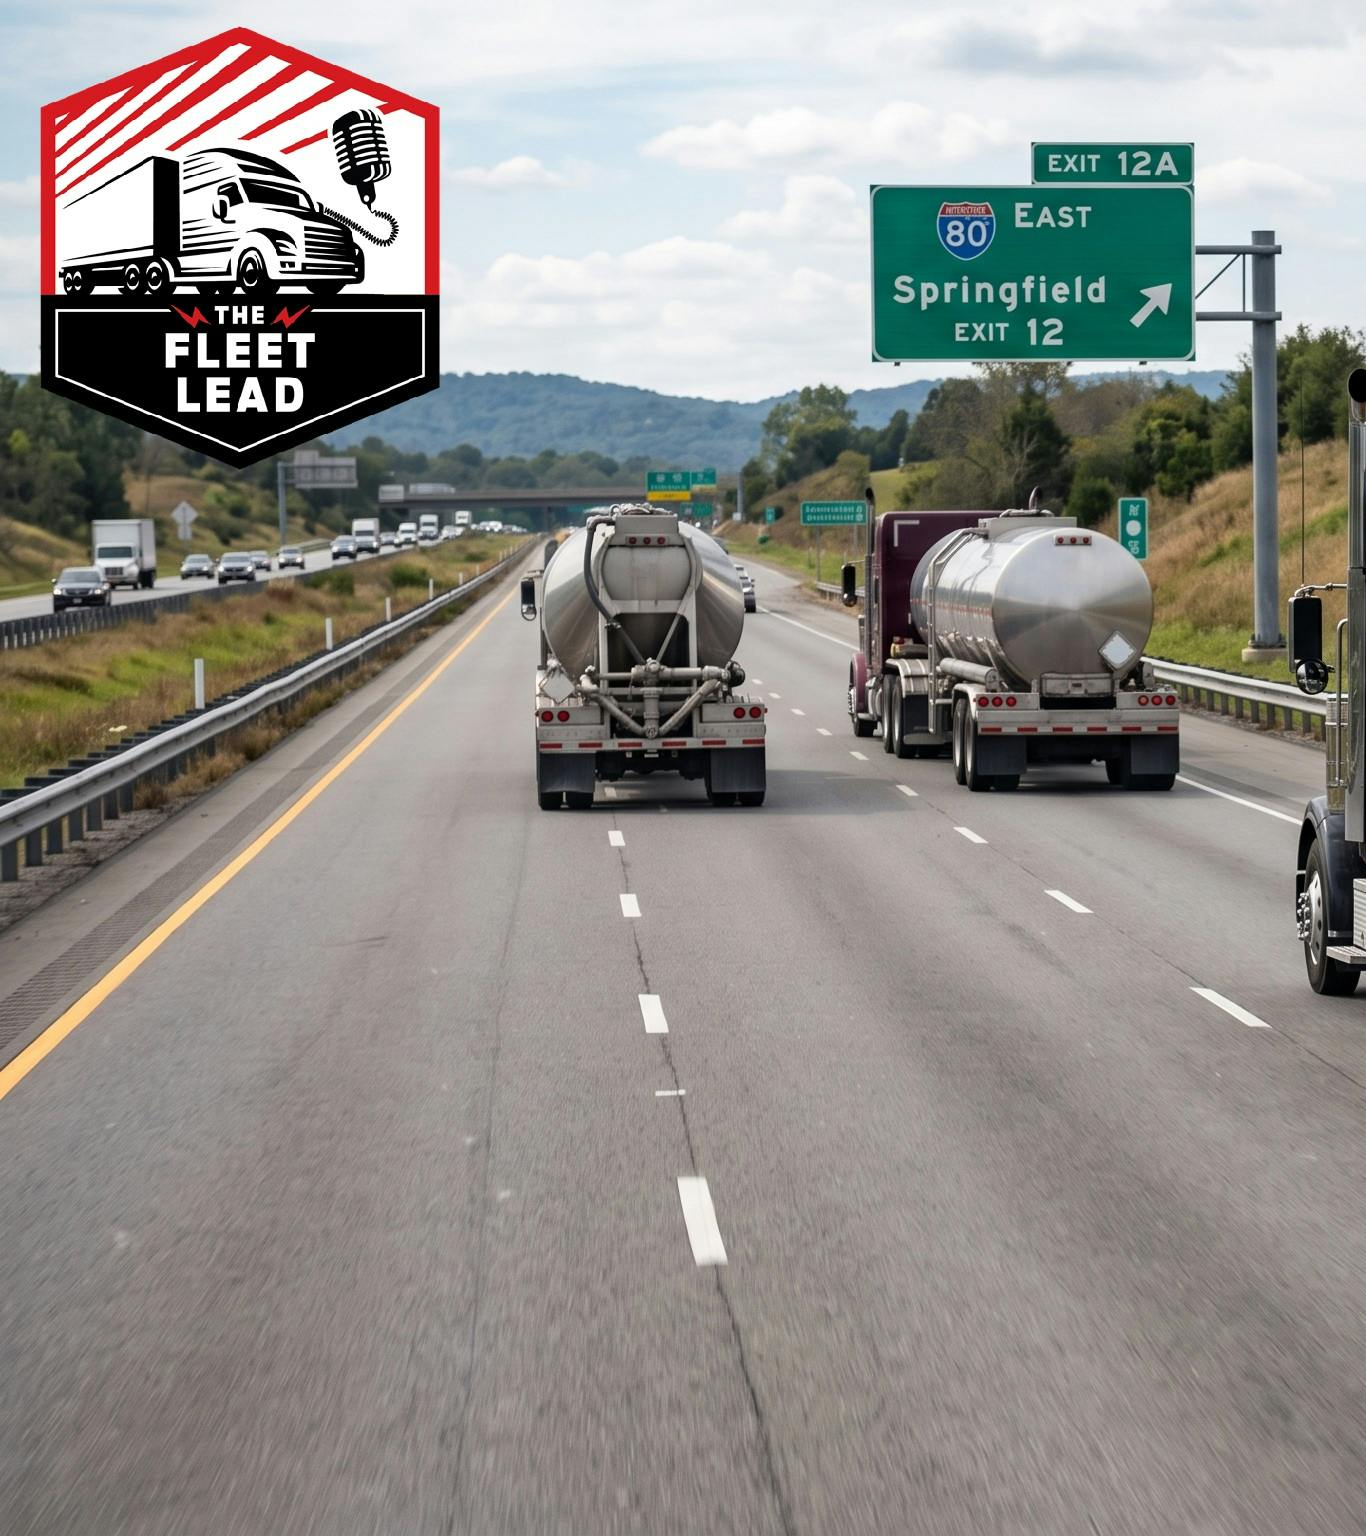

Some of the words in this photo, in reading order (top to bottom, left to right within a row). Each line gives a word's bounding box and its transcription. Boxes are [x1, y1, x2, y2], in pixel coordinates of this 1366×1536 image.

[1049, 155, 1100, 172] EXIT
[1119, 151, 1178, 175] 12A
[946, 220, 987, 247] 80
[1015, 203, 1091, 227] EAST
[893, 275, 1106, 312] Springfield
[955, 323, 1009, 341] EXIT
[1027, 318, 1063, 345] 12
